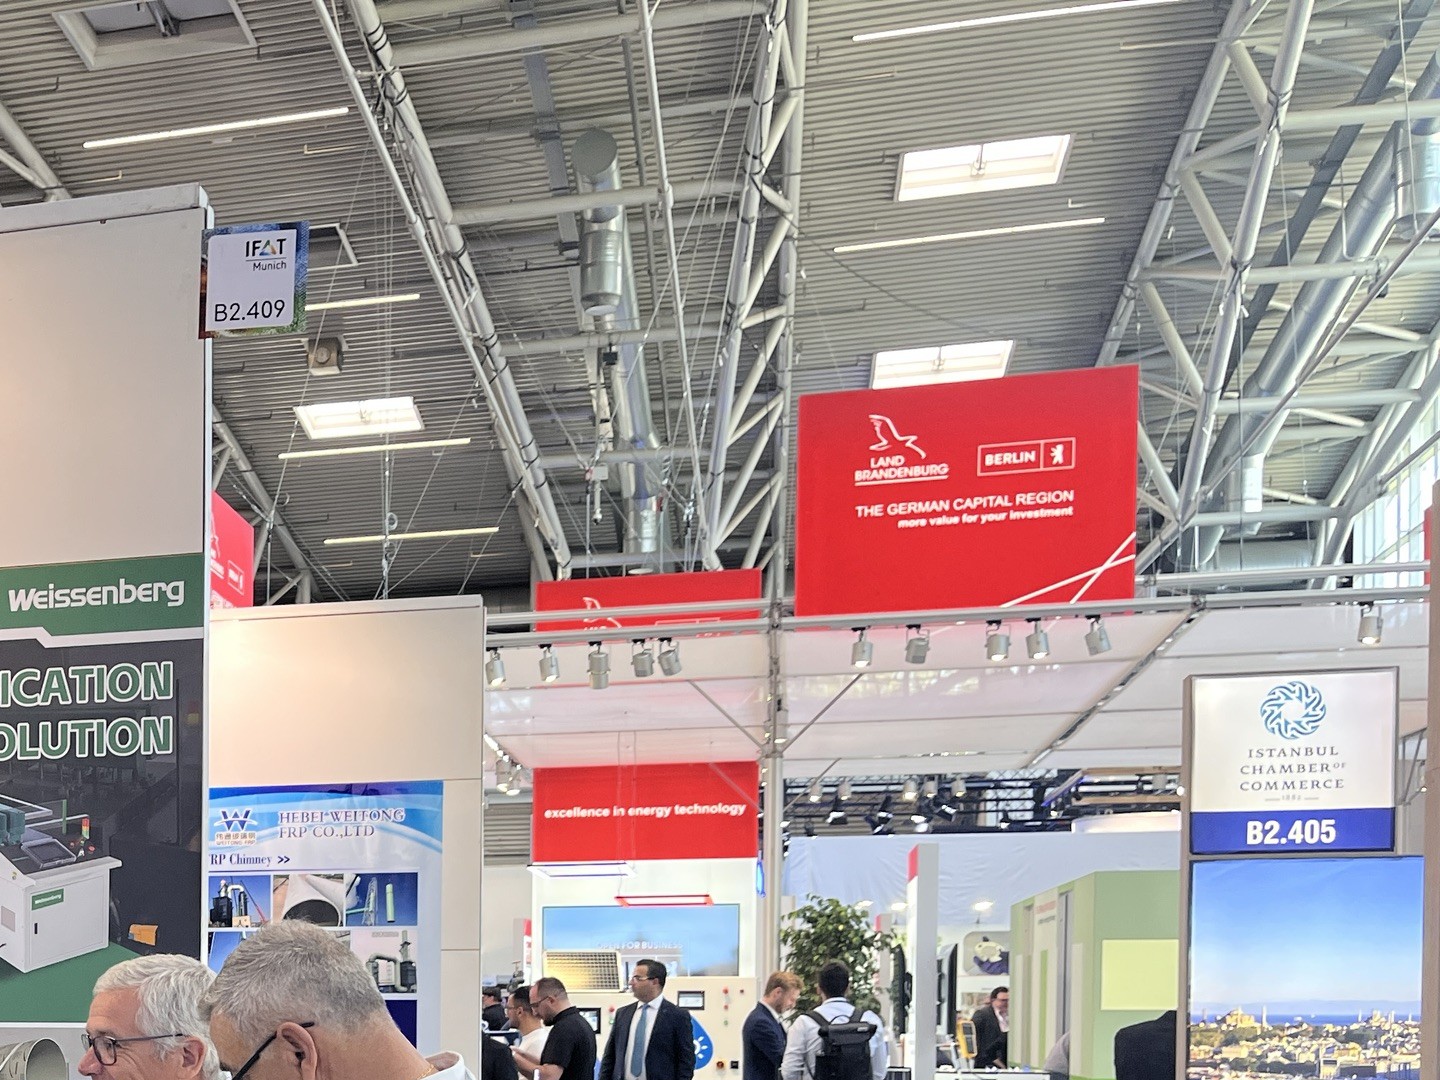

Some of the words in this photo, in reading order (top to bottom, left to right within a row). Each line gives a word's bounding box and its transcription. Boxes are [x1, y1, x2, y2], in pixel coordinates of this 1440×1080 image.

[252, 261, 287, 271] Munich
[214, 300, 286, 322] B2.409
[870, 455, 905, 467] LAND
[984, 451, 1036, 467] BERLIN
[854, 464, 949, 482] BRANDENBURG
[855, 505, 884, 518] THE
[886, 500, 950, 517] GERMAN
[953, 495, 1012, 511] CAPITAL
[1016, 490, 1075, 506] REGION
[898, 518, 927, 528] more
[929, 513, 960, 526] value
[962, 512, 978, 524] for
[980, 511, 1007, 525] your
[1010, 506, 1073, 521] investment
[7, 578, 185, 612] Weissenberg
[1248, 746, 1339, 758] ISTANBUL
[1240, 763, 1331, 775] CHAMBER
[1240, 779, 1344, 791] COMMERCE
[279, 812, 324, 824] HEBEI
[330, 809, 405, 822] WEITONG
[544, 806, 610, 819] excellence
[613, 805, 625, 816] in
[628, 805, 671, 818] energy
[674, 803, 746, 817] technology
[279, 826, 307, 838] FRP
[1246, 819, 1336, 845] B2.405
[209, 854, 226, 865] RP
[229, 854, 273, 867] Chimney
